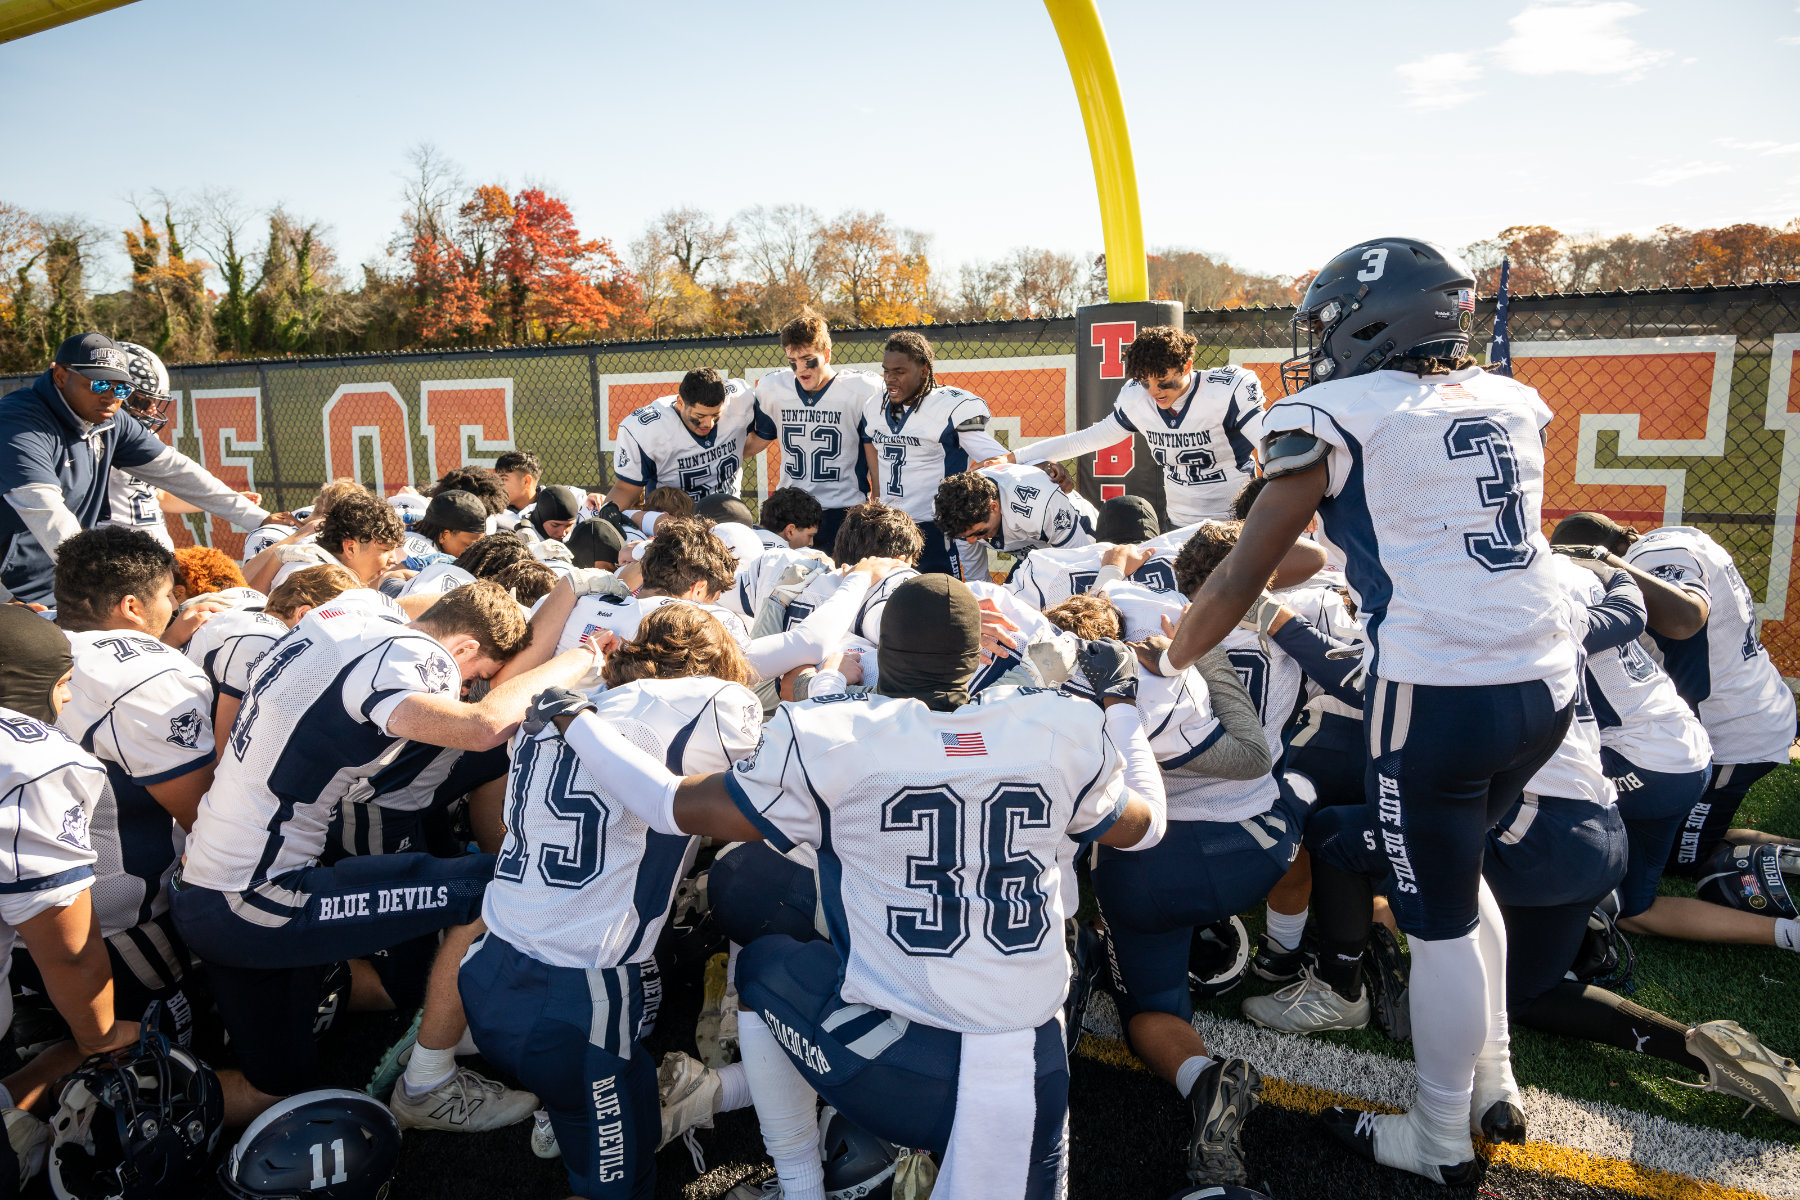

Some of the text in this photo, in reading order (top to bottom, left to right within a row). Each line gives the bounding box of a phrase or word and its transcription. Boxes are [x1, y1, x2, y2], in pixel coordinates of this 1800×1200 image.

[1357, 248, 1389, 282] 3
[781, 409, 842, 425] HUNTINGTON
[677, 438, 737, 469] HUNTINGTON
[781, 424, 843, 483] 52
[1145, 430, 1212, 449] HUNTINGTON
[883, 443, 906, 498] 7
[1152, 448, 1228, 486] 12
[1011, 484, 1041, 519] 14
[1443, 416, 1538, 573] 3
[1613, 772, 1645, 793] BLU
[495, 733, 610, 890] 15
[1378, 773, 1418, 894] BLUE DEVILS
[1677, 803, 1712, 864] BLUE DEVILS
[880, 782, 1053, 958] 36
[1763, 855, 1781, 887] DEVILS
[319, 886, 448, 921] BLUE DEVILS
[166, 989, 192, 1031] BLUE
[642, 976, 663, 1023] DEVILS
[764, 1008, 832, 1075] BLUE DEVILS
[1715, 1063, 1761, 1096] balance
[592, 1075, 624, 1183] BLUE DEVILS
[309, 1138, 348, 1190] 11
